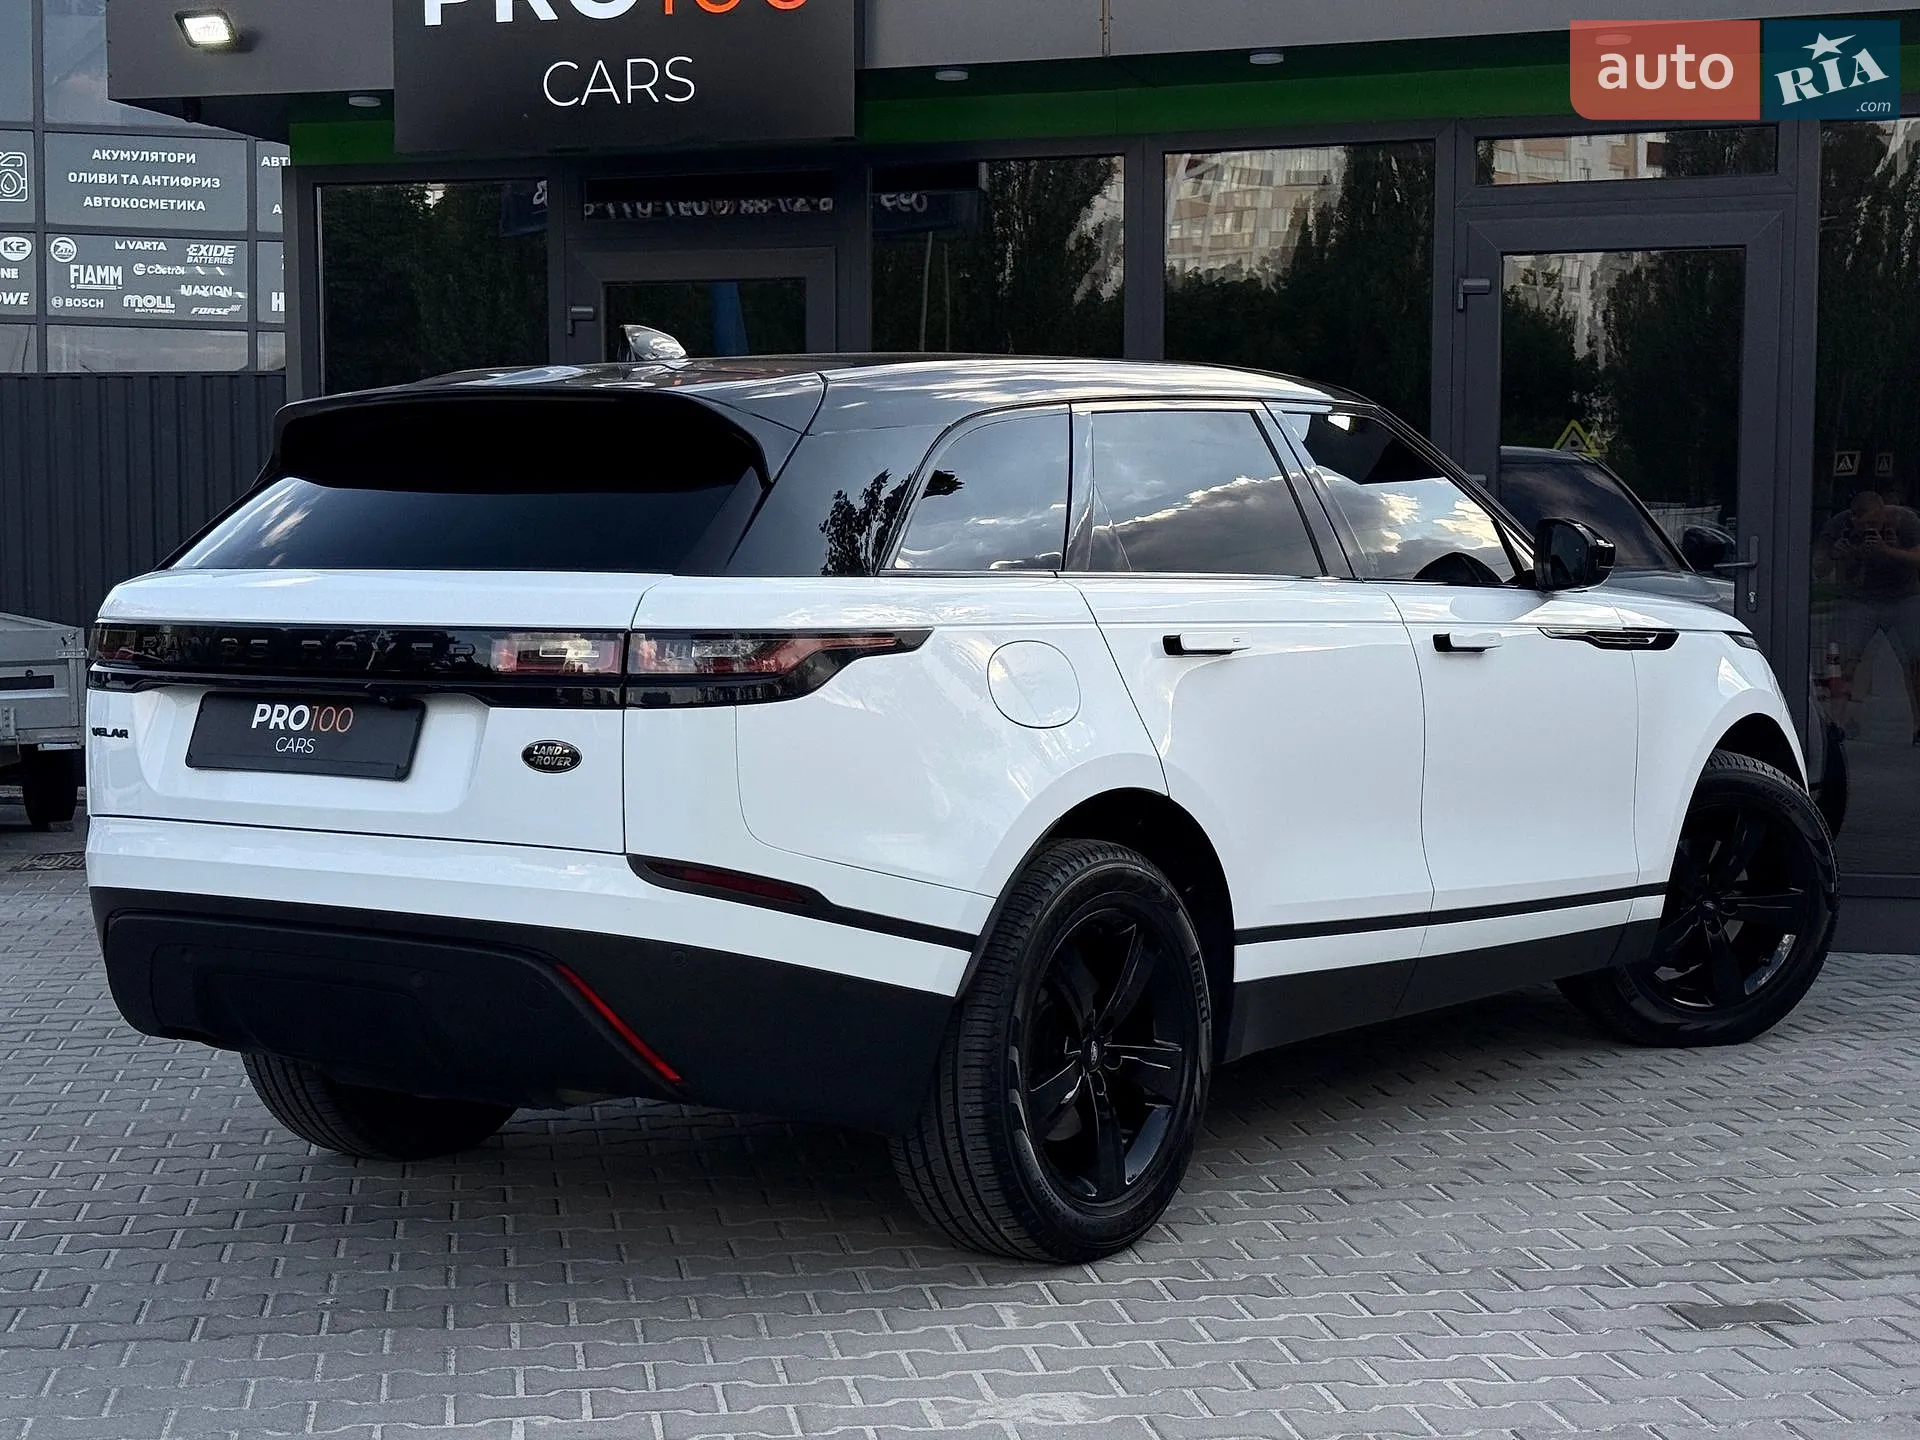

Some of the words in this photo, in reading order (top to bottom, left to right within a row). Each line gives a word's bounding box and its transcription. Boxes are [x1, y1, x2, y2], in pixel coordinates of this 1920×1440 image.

[543, 56, 696, 107] CARS
[91, 149, 197, 164] АКУМУЛЯТОРИ
[261, 156, 290, 167] АВТ
[68, 172, 118, 185] ОЛИВИ
[121, 174, 138, 185] ТА
[142, 175, 221, 188] АНТИФРИЗ
[83, 196, 206, 212] АВТОКОСМЕТИКА
[3, 241, 27, 252] K2
[127, 241, 167, 251] VARTA
[188, 244, 236, 257] EXIDE
[186, 256, 235, 264] BATTERIES
[70, 264, 123, 285] FIAMM
[146, 263, 186, 276] Castrol
[65, 298, 104, 308] BOSCH
[190, 307, 231, 315] FORSE
[251, 703, 353, 732] PRO100
[92, 727, 129, 739] VELAR
[275, 736, 316, 753] CARS
